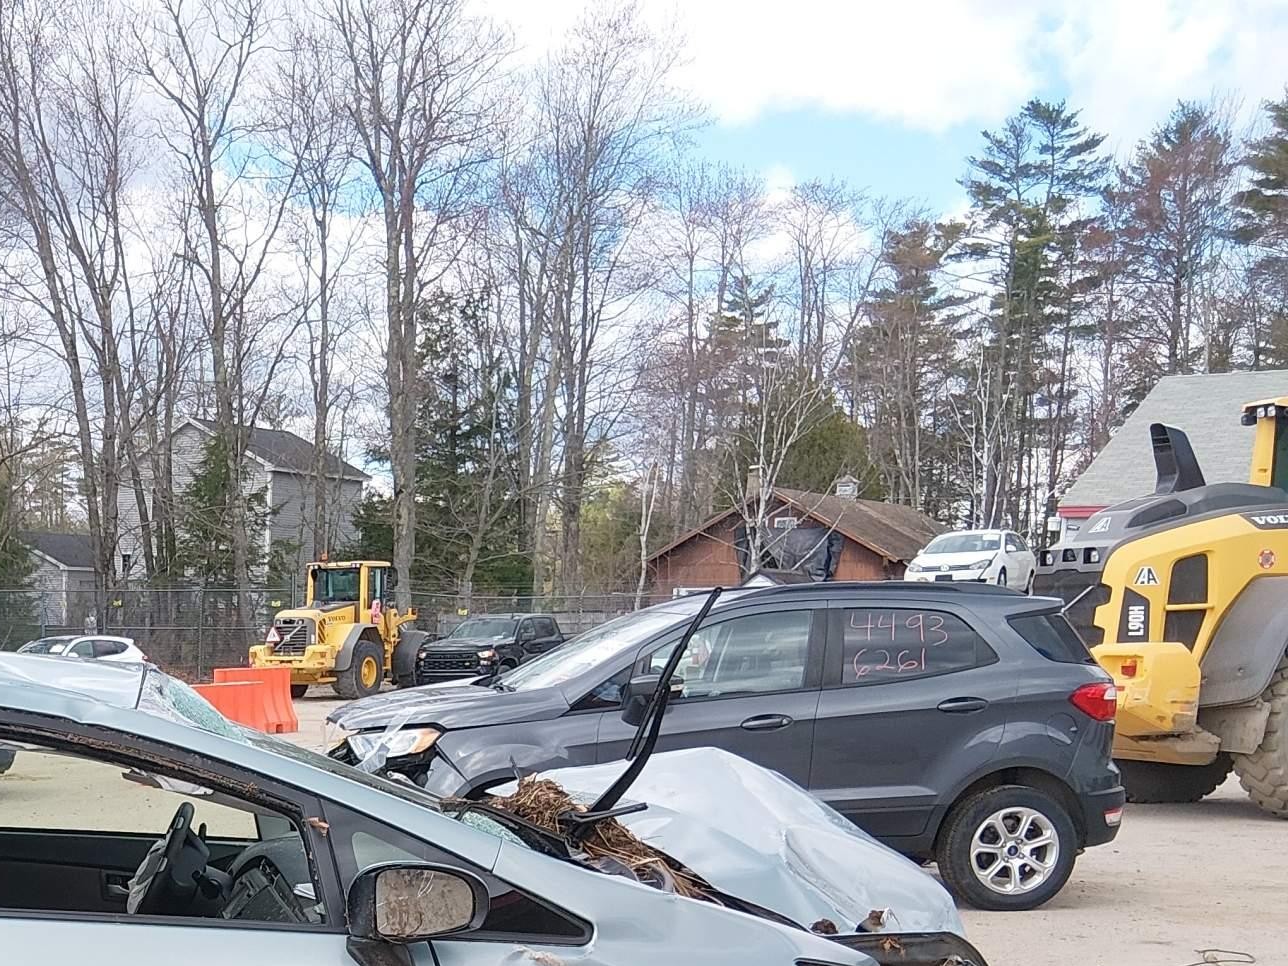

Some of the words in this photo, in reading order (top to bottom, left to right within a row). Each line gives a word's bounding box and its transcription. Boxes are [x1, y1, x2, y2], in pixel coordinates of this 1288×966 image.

[1252, 514, 1288, 525] VOL
[850, 612, 948, 646] 4493
[1127, 605, 1145, 636] L90H
[853, 648, 925, 680] 6261
